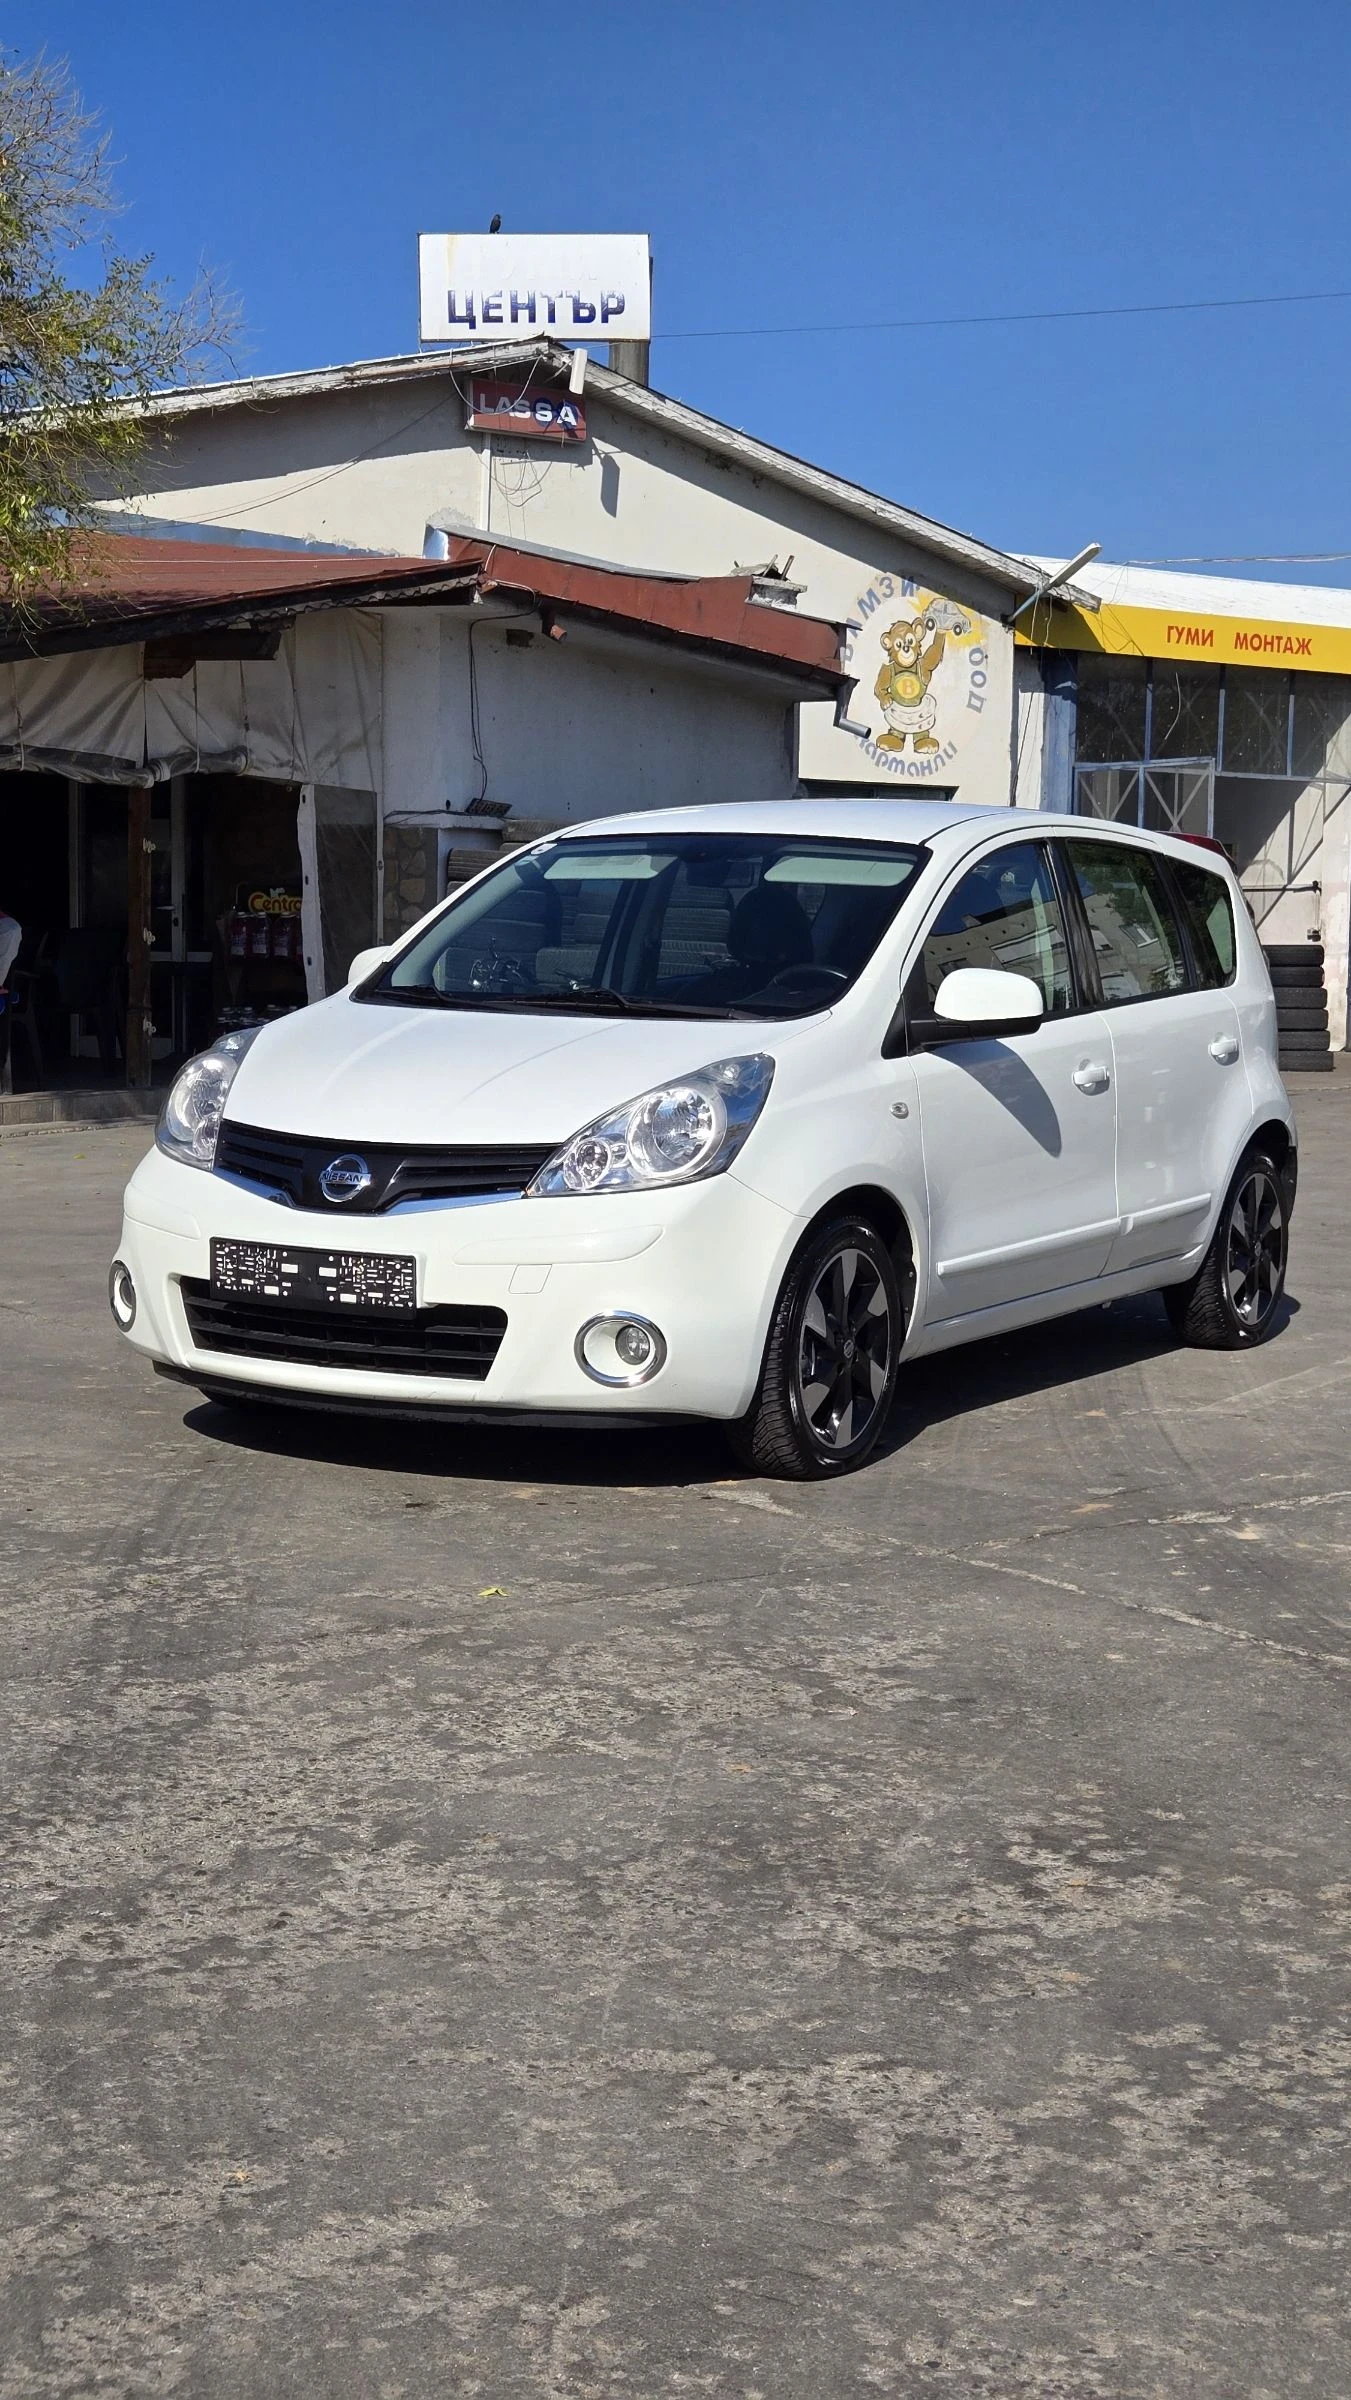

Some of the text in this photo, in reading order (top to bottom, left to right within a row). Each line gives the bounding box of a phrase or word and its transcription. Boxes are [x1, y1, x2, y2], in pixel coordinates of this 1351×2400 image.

[447, 290, 626, 330] ЦЕНТЪР
[479, 393, 578, 426] LASSA
[1166, 626, 1312, 656] ГУМИ МОНТАЖ
[322, 1171, 363, 1183] NISSAN
